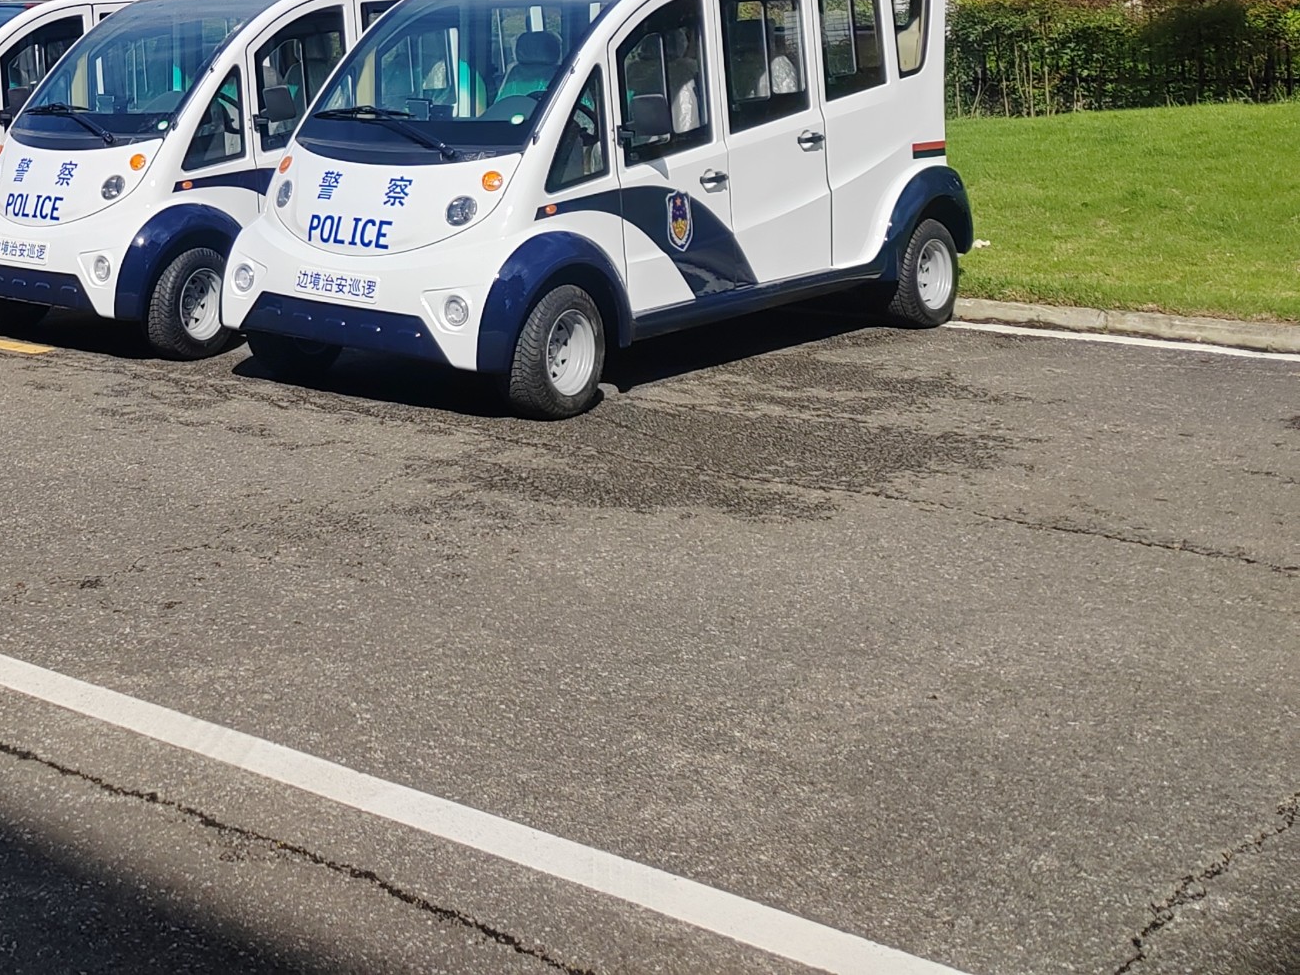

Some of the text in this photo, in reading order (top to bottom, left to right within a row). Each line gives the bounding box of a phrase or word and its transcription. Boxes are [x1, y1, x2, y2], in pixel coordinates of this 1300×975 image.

[13, 157, 78, 187] 警察
[317, 170, 413, 207] 警察
[5, 193, 63, 221] POLICE
[308, 214, 393, 250] POLICE
[296, 270, 377, 300] 边境治安巡逻
